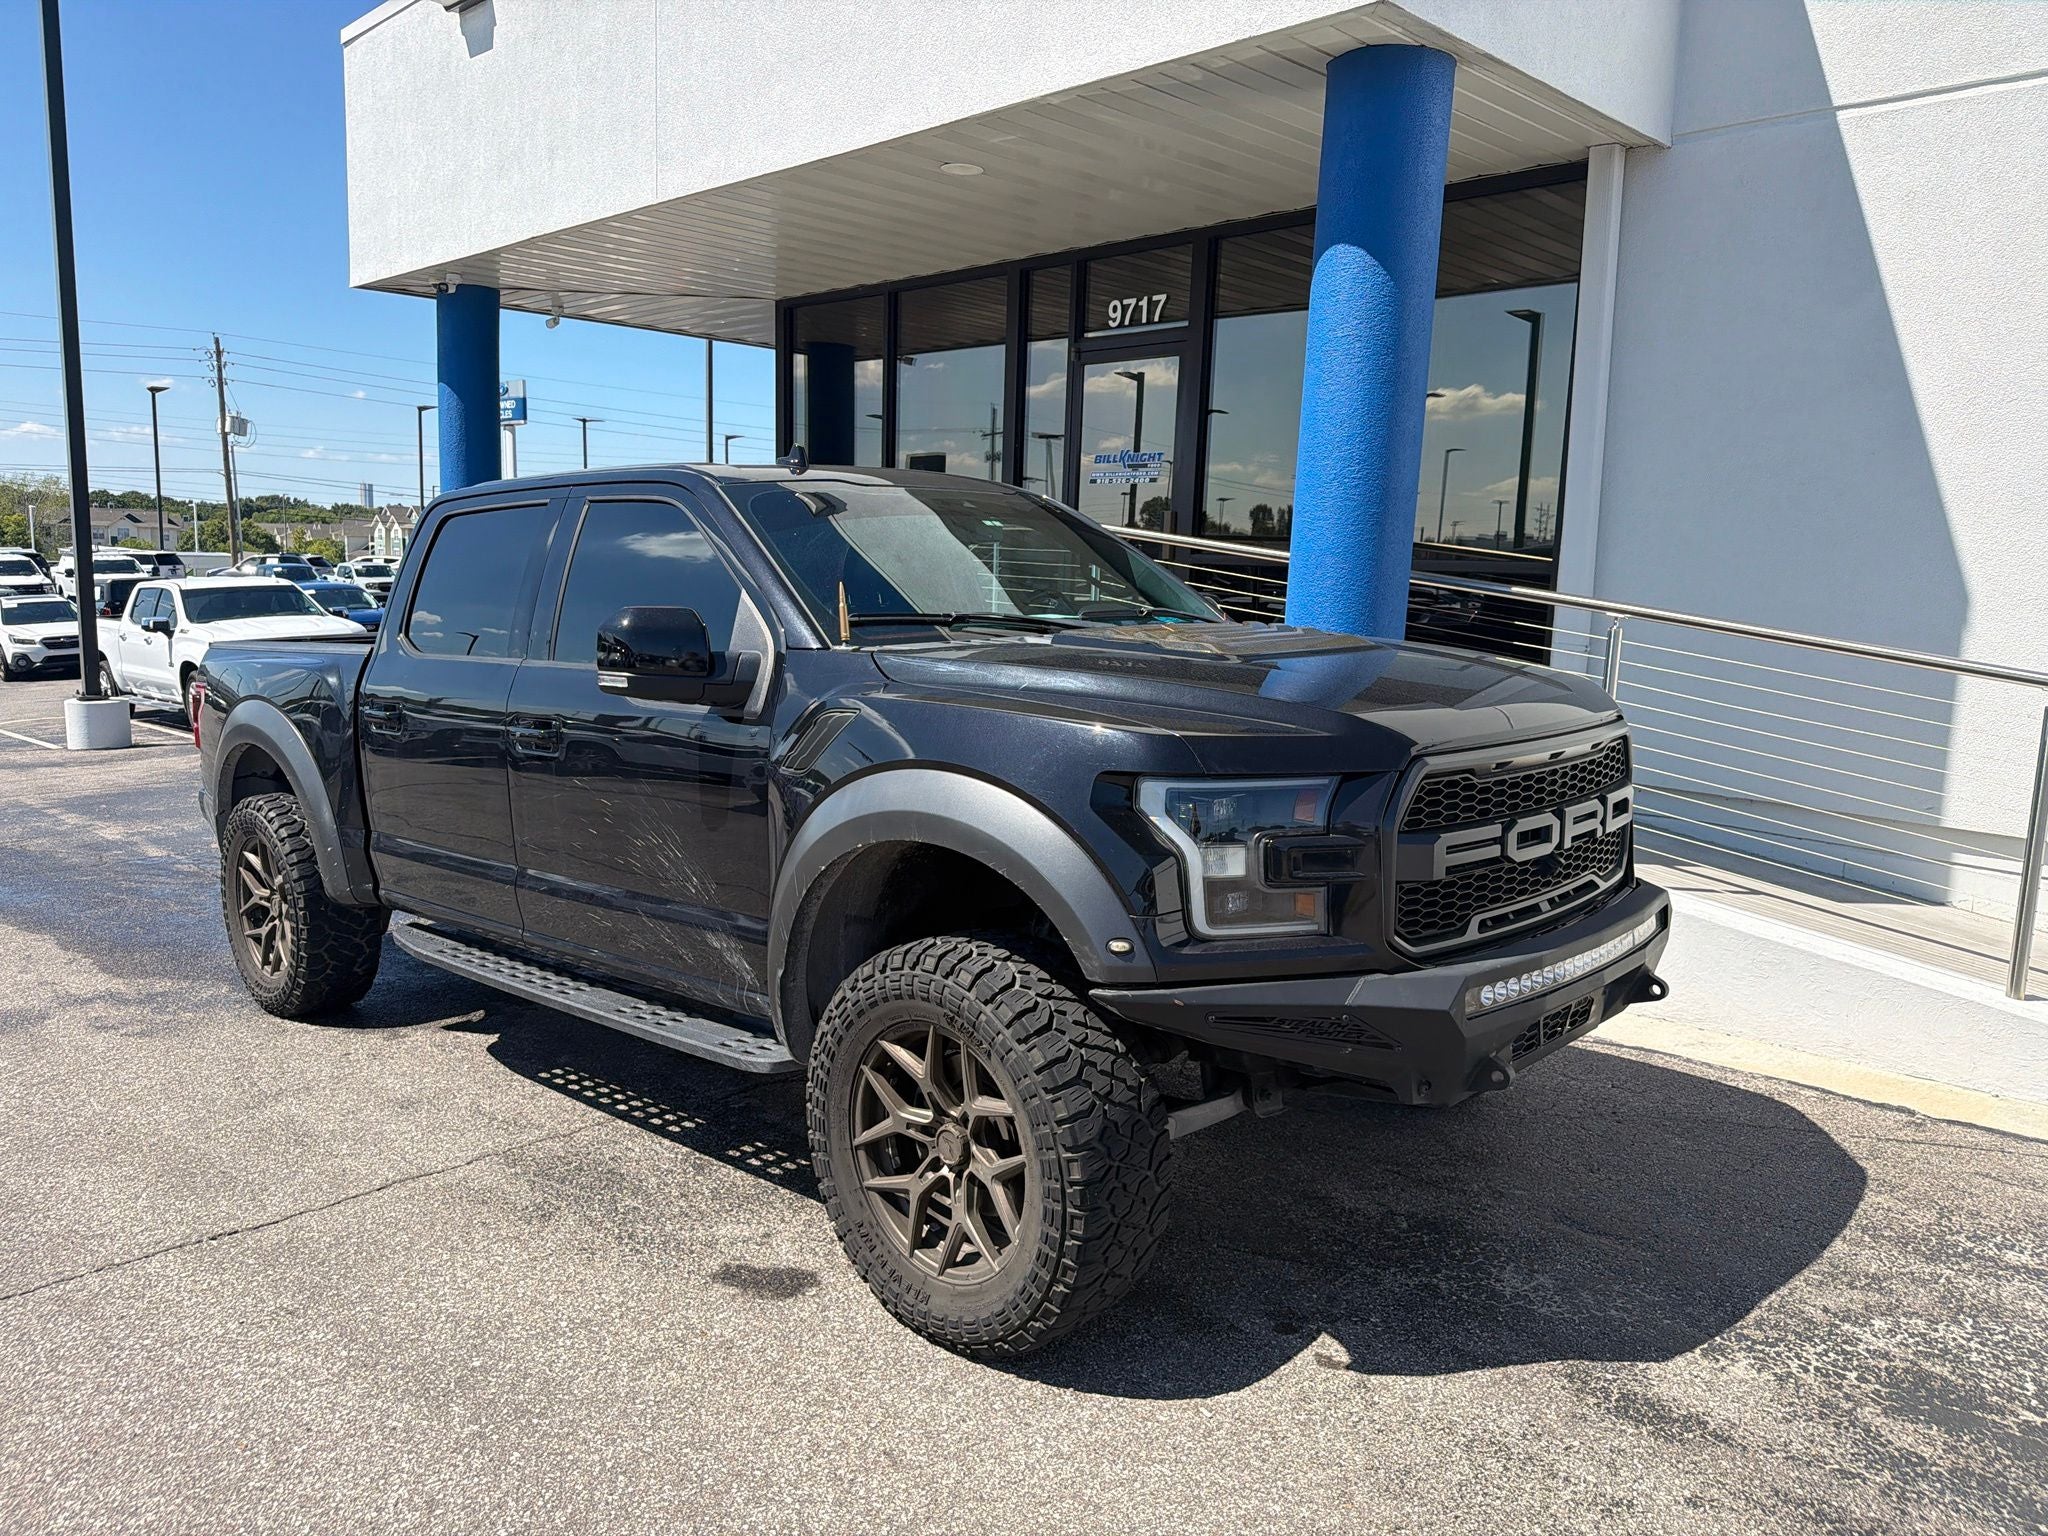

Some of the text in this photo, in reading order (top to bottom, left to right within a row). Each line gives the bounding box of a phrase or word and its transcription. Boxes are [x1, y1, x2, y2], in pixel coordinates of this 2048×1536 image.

[1108, 293, 1168, 328] 9717
[1433, 784, 1635, 881] FORD
[876, 1254, 931, 1305] KLEVER
